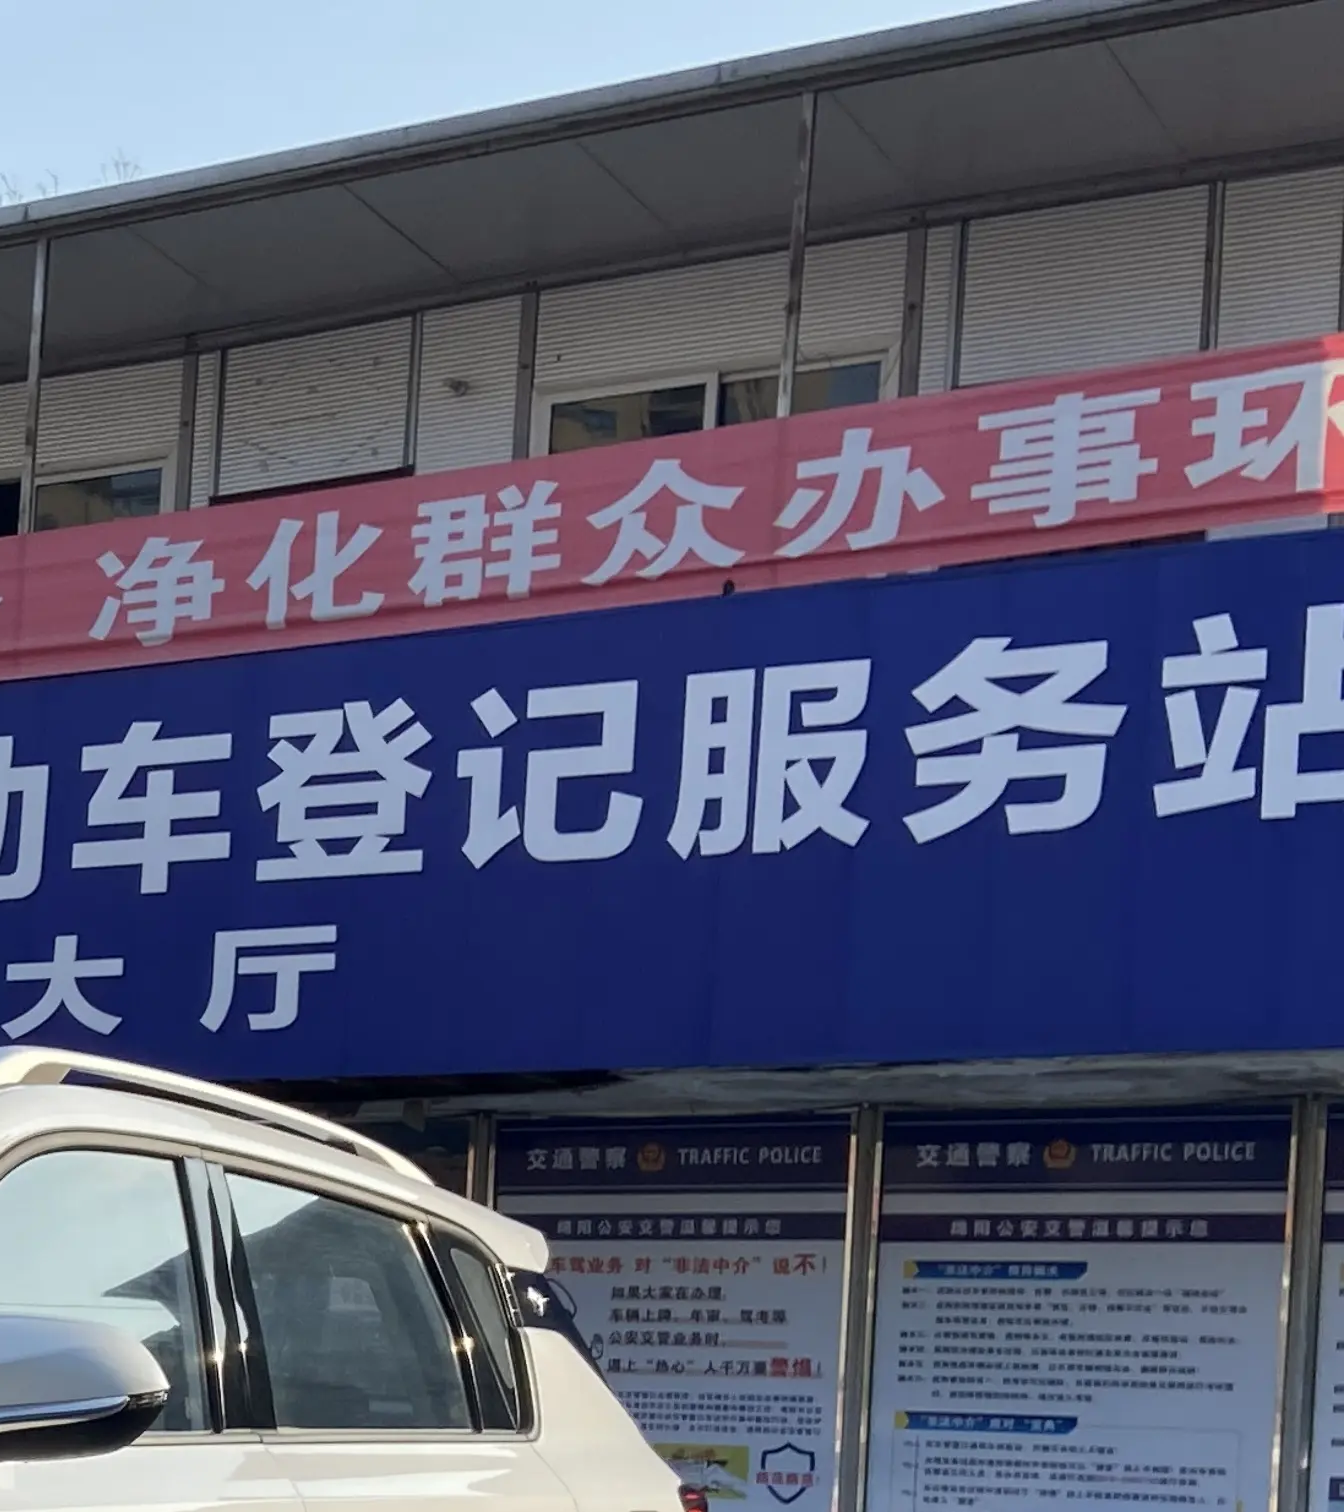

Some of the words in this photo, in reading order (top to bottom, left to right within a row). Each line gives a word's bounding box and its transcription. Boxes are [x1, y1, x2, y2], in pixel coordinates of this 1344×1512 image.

[89, 361, 1344, 649] 净化群众办事环
[525, 1147, 627, 1171] 交通警察
[678, 1147, 750, 1166] TRAFFIC
[758, 1145, 823, 1165] POLICE
[915, 1142, 1031, 1168] 交通警察
[1091, 1143, 1172, 1163] TRAFFIC
[1182, 1141, 1256, 1161] POLICE
